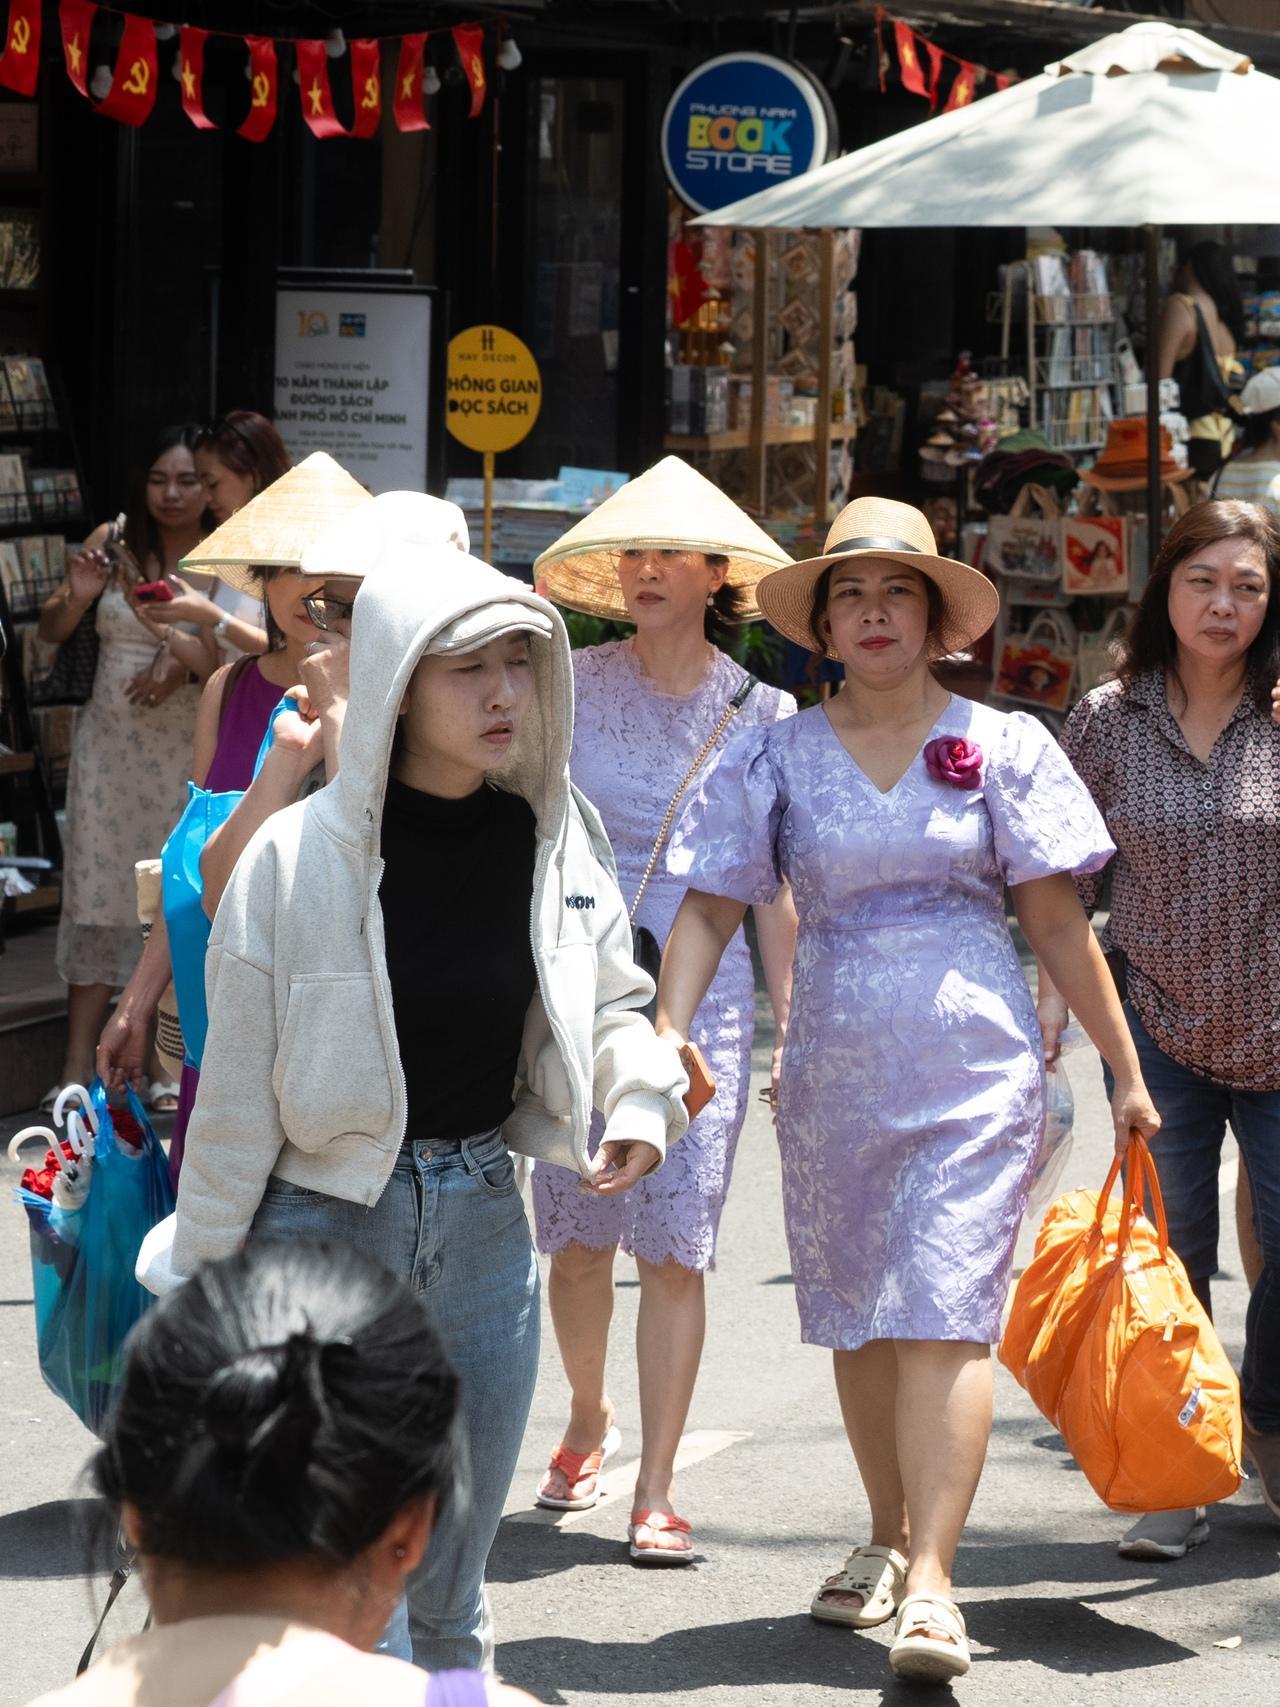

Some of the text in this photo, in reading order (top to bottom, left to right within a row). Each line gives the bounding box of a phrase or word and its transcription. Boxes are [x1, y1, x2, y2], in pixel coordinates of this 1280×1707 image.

[760, 106, 798, 119] NAM
[688, 114, 793, 154] BOOK
[685, 150, 793, 175] STORE
[482, 353, 517, 364] DECOR
[500, 378, 538, 394] GIAN
[340, 393, 374, 407] SÁCH
[487, 396, 528, 415] SÁCH
[375, 412, 407, 425] MINH
